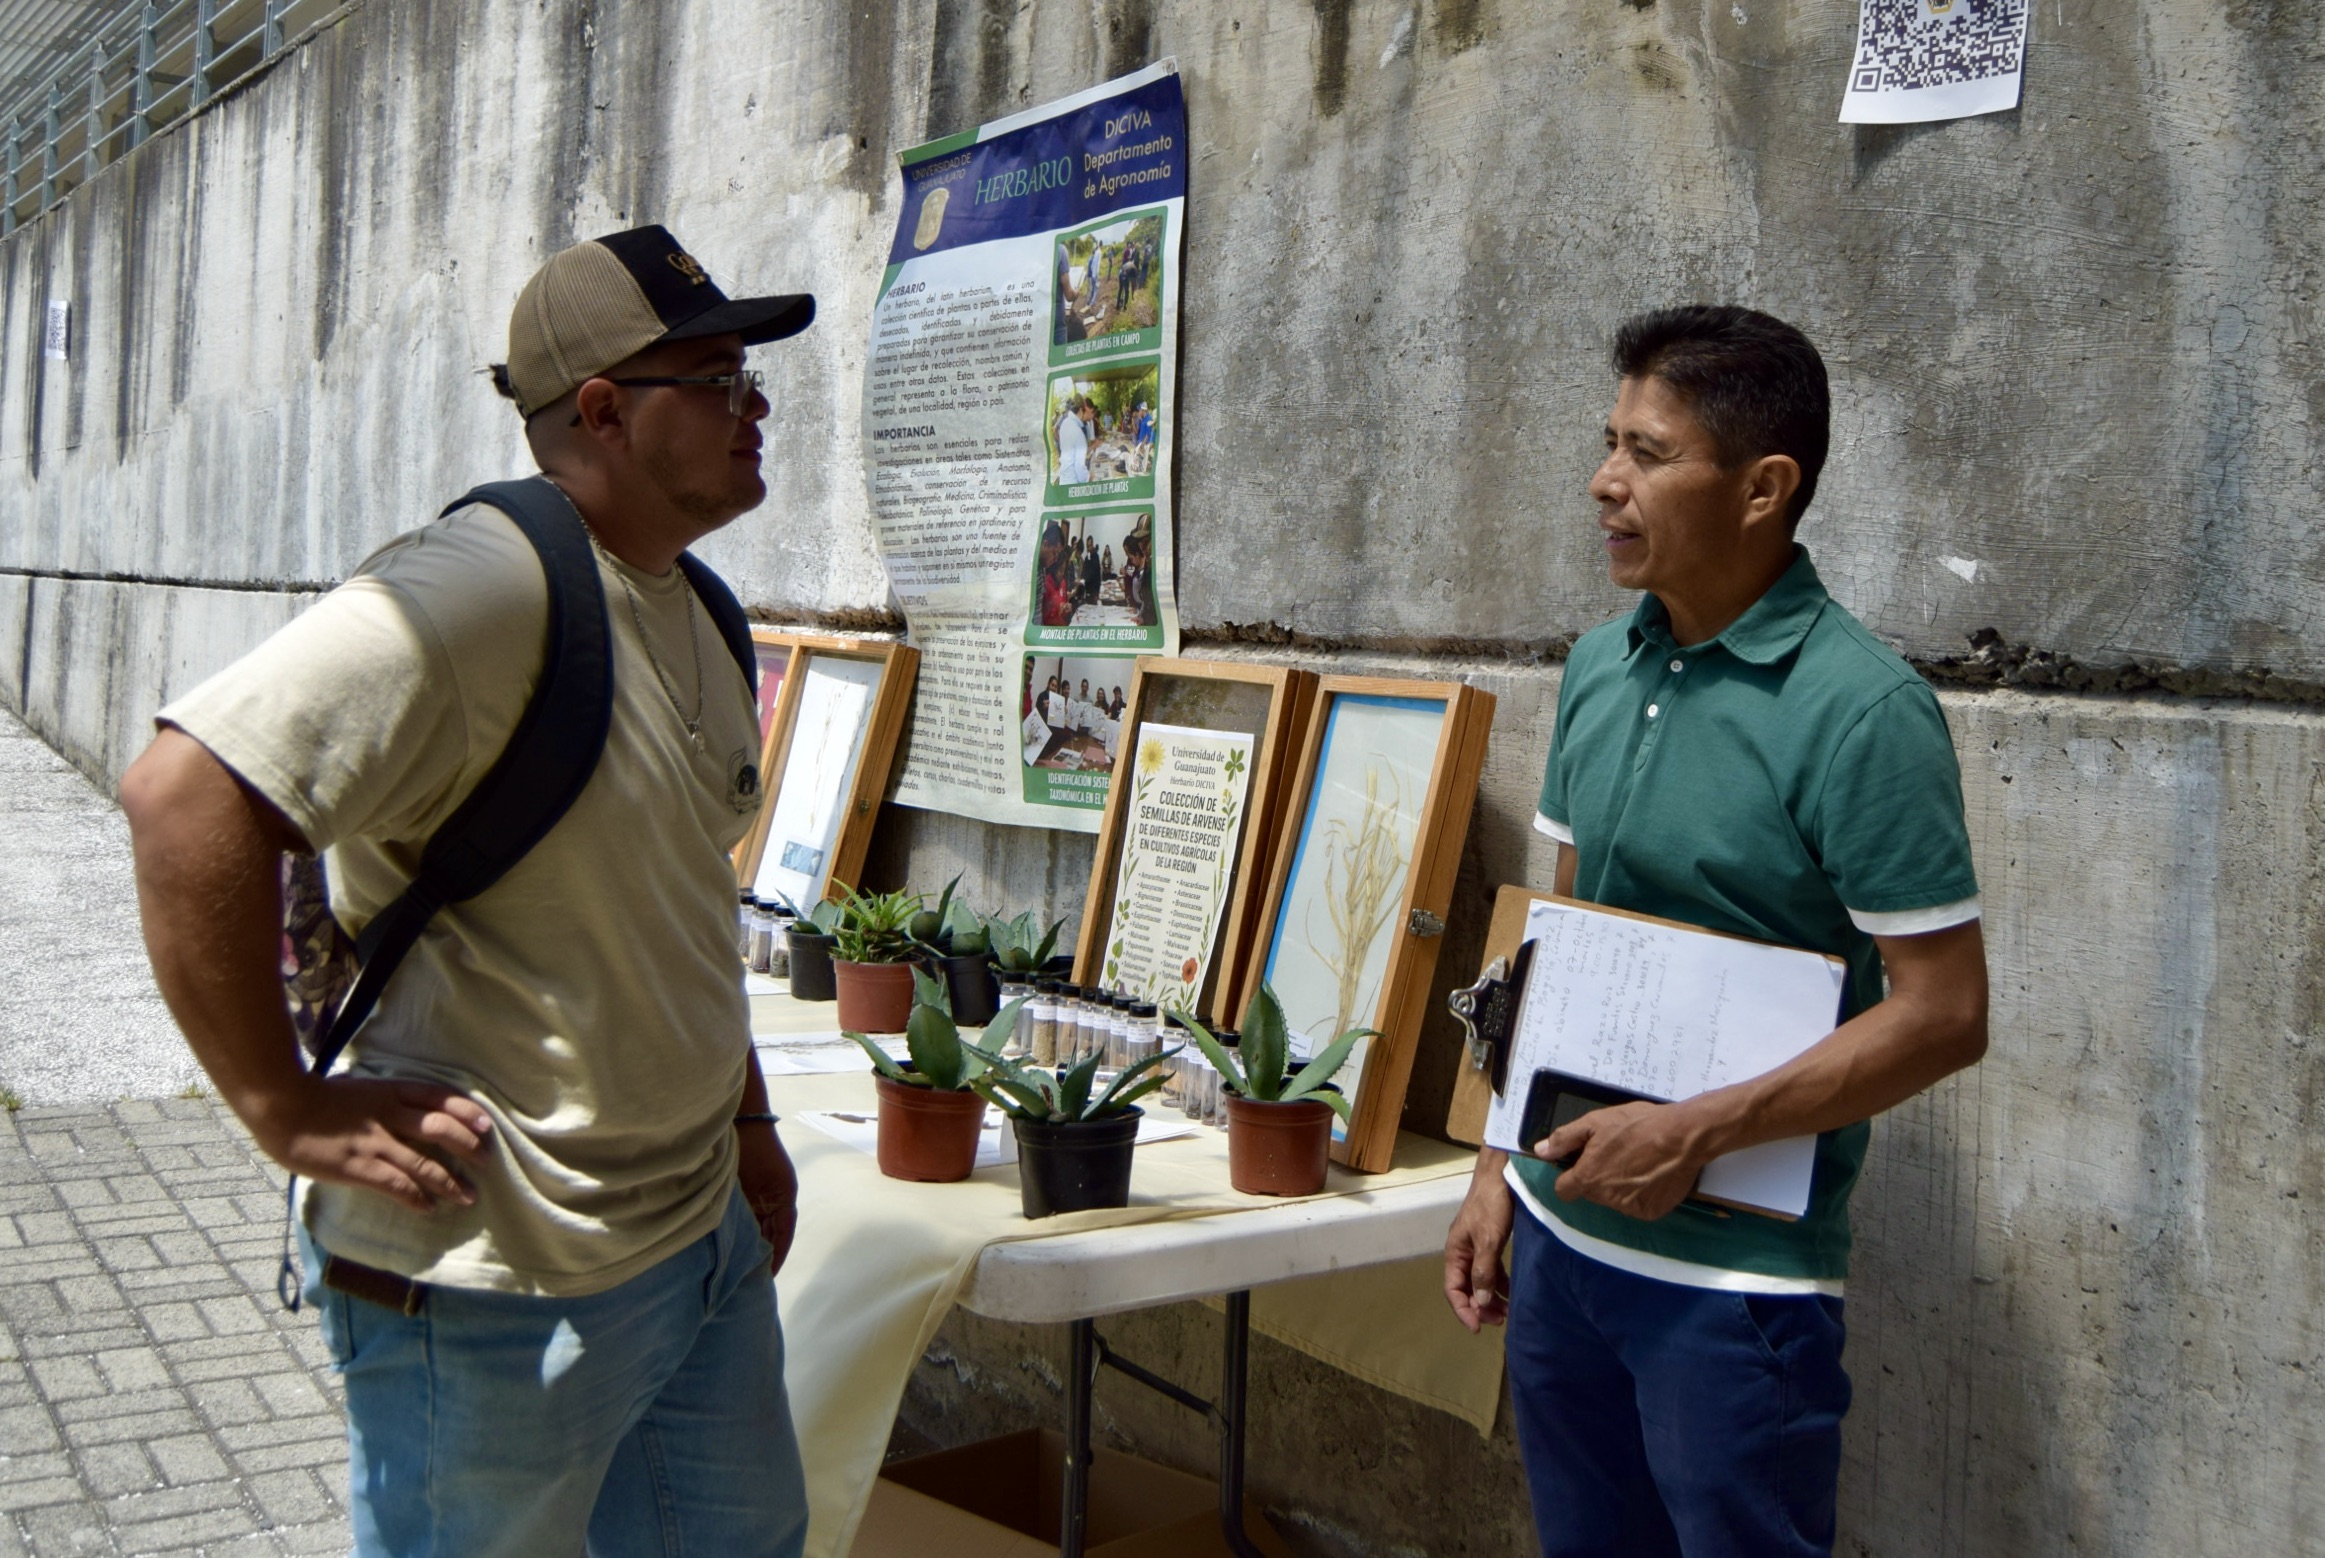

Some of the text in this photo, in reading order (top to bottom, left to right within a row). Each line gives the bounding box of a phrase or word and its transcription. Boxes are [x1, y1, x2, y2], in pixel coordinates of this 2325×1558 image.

[1105, 109, 1152, 140] DICIVA
[1084, 135, 1172, 172] Departamento
[912, 153, 972, 182] UNIVERSIDAD DE
[918, 169, 966, 193] GUANAJUATO
[975, 156, 1072, 206] HERBARIO
[1084, 161, 1171, 199] de Agronomía
[886, 281, 926, 299] HERBARIO
[927, 293, 936, 304] del
[1021, 281, 1035, 289] una
[936, 305, 945, 315] de
[947, 303, 971, 316] plantas
[1003, 294, 1012, 305] de
[921, 316, 961, 331] identificadas
[989, 308, 1034, 321] debidamente
[913, 337, 928, 348] para
[929, 331, 965, 346] garantizar
[1022, 320, 1032, 331] de
[1085, 341, 1092, 352] DE
[1091, 337, 1112, 351] PLANTAS
[1112, 336, 1120, 347] EN
[1120, 332, 1140, 346] CAMPO
[941, 347, 954, 357] que
[956, 342, 990, 354] contienen
[874, 366, 891, 377] sobre
[893, 364, 900, 375] el
[902, 363, 918, 376] lugar
[920, 361, 929, 371] de
[975, 353, 1001, 365] nombre
[1002, 350, 1022, 362] común
[889, 379, 905, 389] entre
[957, 371, 975, 381] Estas
[983, 367, 1018, 378] colecciones
[1021, 366, 1030, 374] en
[901, 389, 935, 403] representa
[950, 385, 958, 396] la
[899, 398, 980, 415] de una localidad, región
[873, 425, 936, 441] IMPORTANCIA
[926, 443, 938, 451] son
[944, 437, 978, 449] esenciales
[984, 437, 1002, 448] para
[955, 451, 971, 462] tales
[974, 452, 993, 461] como
[925, 476, 1031, 489] conservación de recursos
[1102, 483, 1109, 494] DE
[1109, 480, 1129, 494] PLANTAS
[960, 504, 990, 514] Genética
[1008, 506, 1026, 516] para
[926, 520, 934, 530] de
[936, 518, 966, 529] referencia
[952, 534, 962, 542] son
[981, 529, 1007, 541] fuente
[1011, 530, 1021, 541] de
[927, 547, 934, 557] de
[943, 545, 964, 558] plantas
[971, 543, 981, 554] del
[982, 544, 1008, 554] medio
[985, 559, 1015, 571] registro
[1040, 628, 1148, 640] MONTAJE DE PLANTAS EN EL HERBARIO
[1172, 746, 1225, 763] Universidad de
[1174, 760, 1216, 776] Guanajuato
[1047, 772, 1092, 787] IDENTIFICACIÓN
[1170, 776, 1215, 790] Herbario DICIVA
[1049, 787, 1084, 803] TAXONÓMICA
[1085, 791, 1093, 804] EN
[1094, 792, 1101, 805] EL
[1159, 790, 1217, 812] COLECCIÓN DE
[1140, 805, 1226, 832] SEMILLAS DE ARVENSE
[1139, 822, 1221, 848] DE DIFERENTES ESPECIES
[1140, 838, 1217, 862] EN CULTIVOS AGRÍCOLAS
[1155, 856, 1197, 874] DE LA REGIÓN
